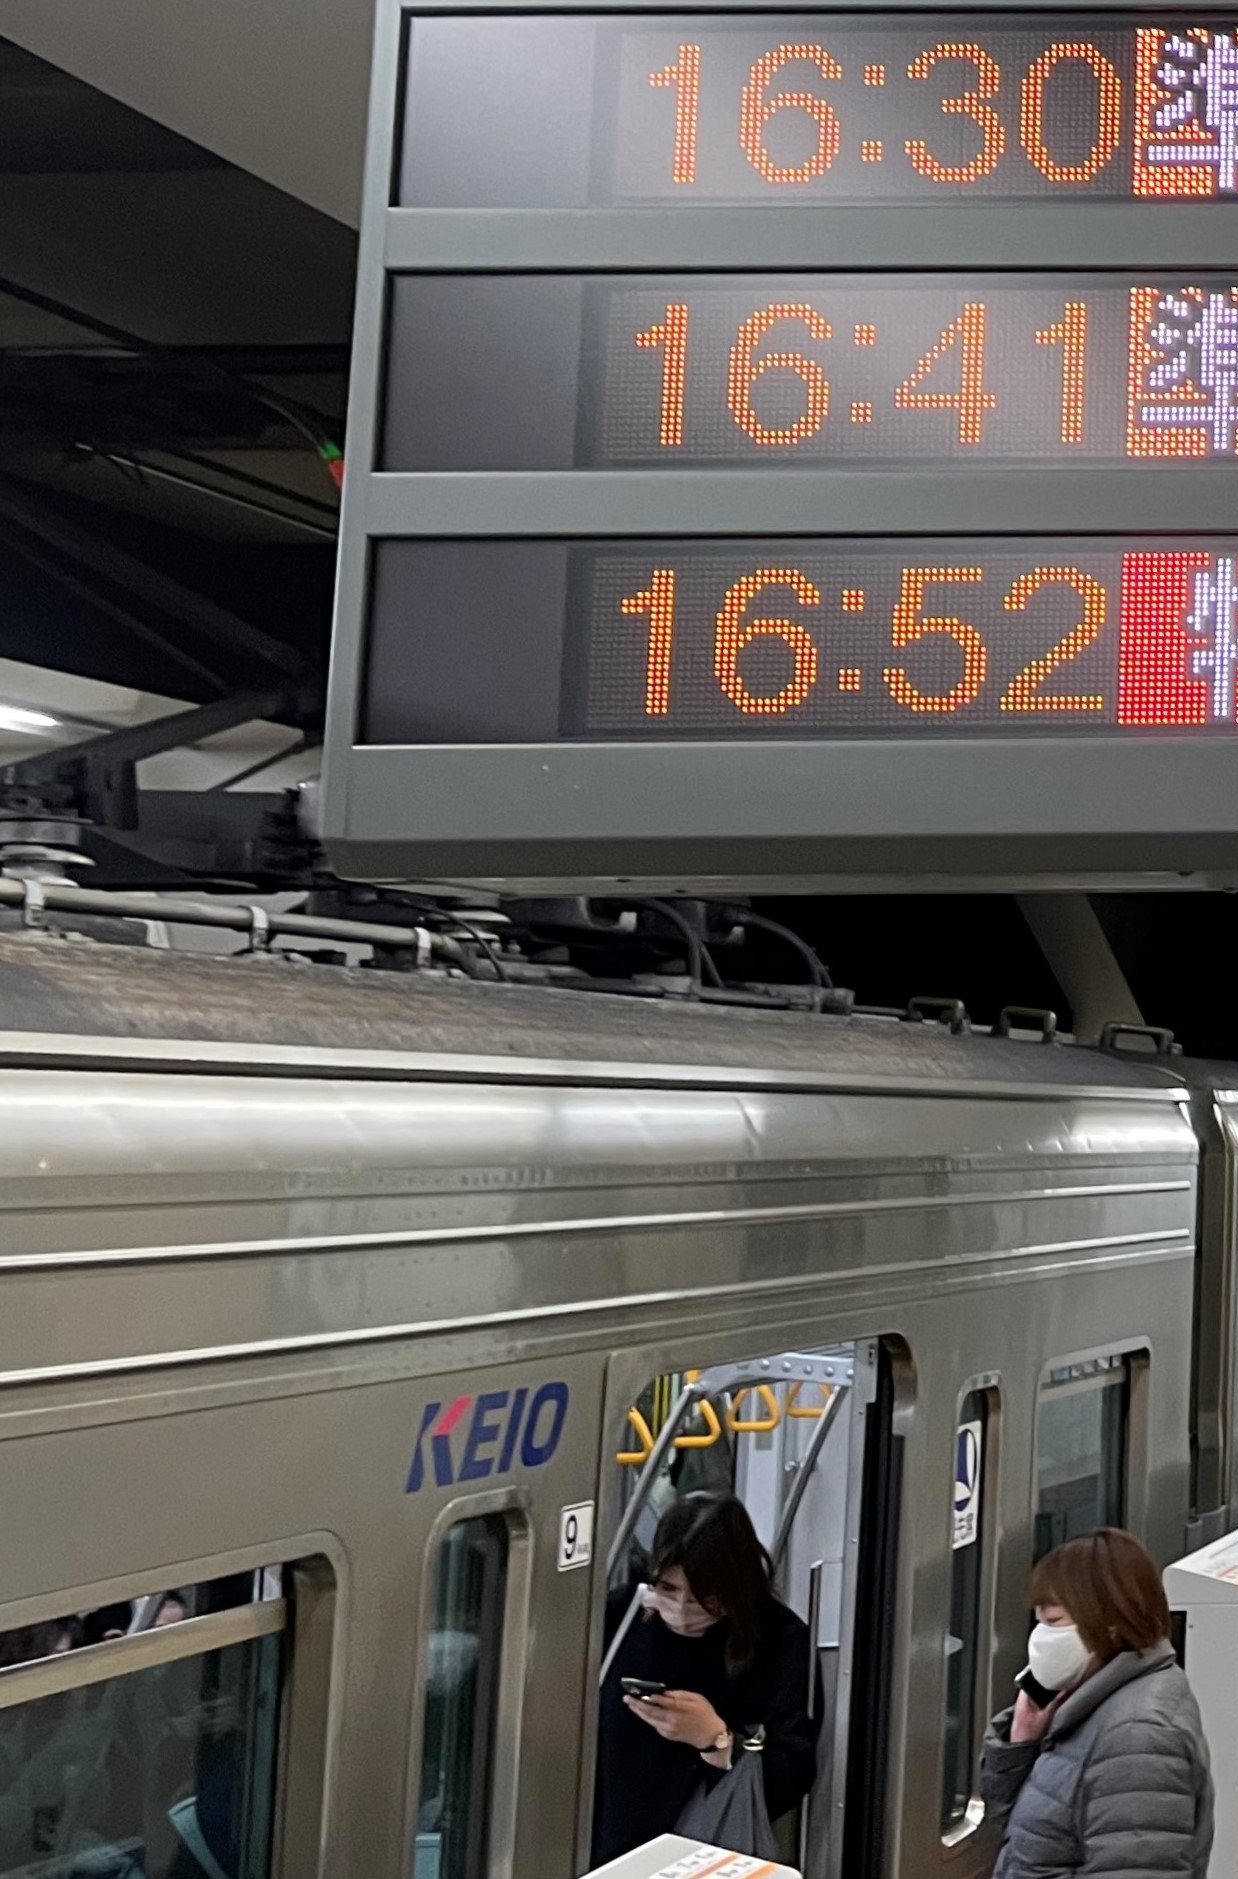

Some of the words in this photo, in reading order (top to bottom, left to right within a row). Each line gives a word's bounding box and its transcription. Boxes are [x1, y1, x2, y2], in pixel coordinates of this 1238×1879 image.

[648, 42, 1121, 184] 16:30
[635, 302, 1087, 446] 16:41
[620, 566, 1105, 715] 16:52
[404, 1381, 569, 1494] KEIO
[564, 1513, 578, 1560] 9
